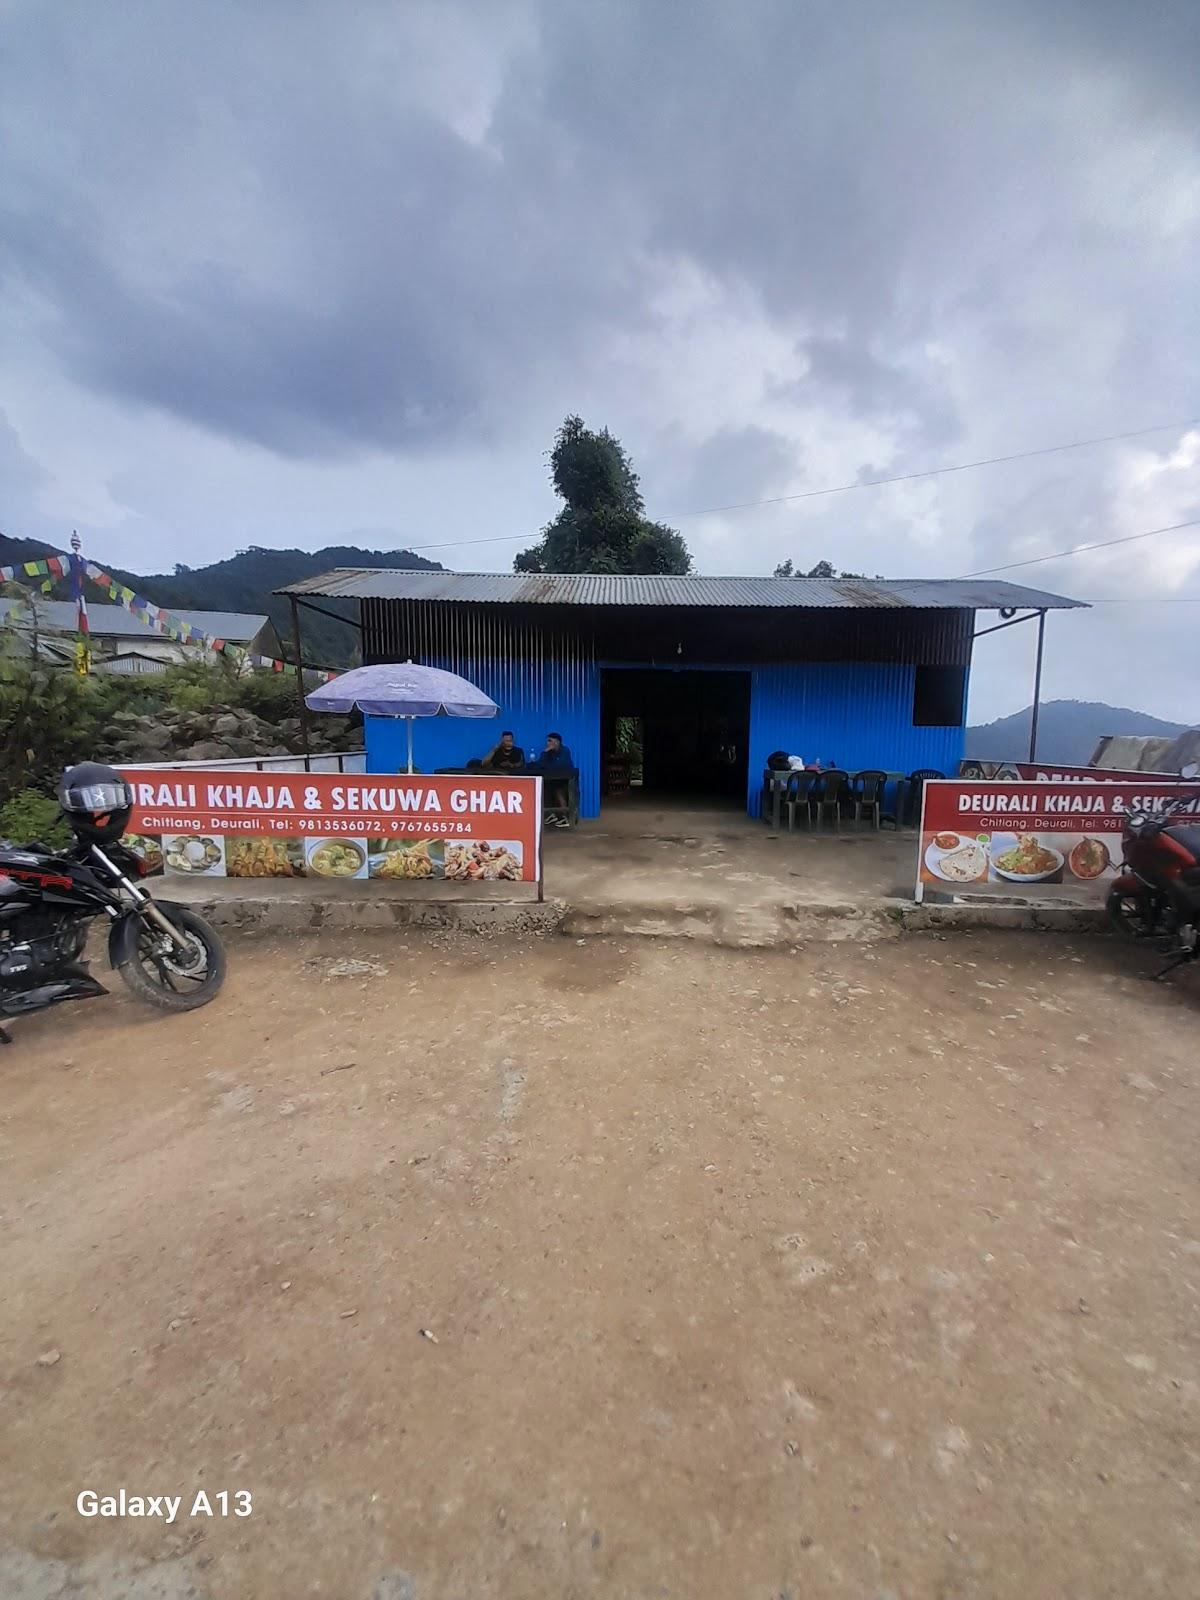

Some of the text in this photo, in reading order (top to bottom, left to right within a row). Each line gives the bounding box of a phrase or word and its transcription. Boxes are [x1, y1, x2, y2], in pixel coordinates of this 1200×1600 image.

[207, 784, 295, 809] KHAJA
[303, 786, 321, 810] &
[331, 787, 442, 812] SEKUWA
[450, 789, 523, 813] GHAR
[958, 794, 1038, 812] DEURALI
[1044, 795, 1106, 813] KHAJA
[1111, 796, 1125, 813] &
[142, 817, 472, 833] Chitlang, Deurali, Tel: 9813536072, 9767655784
